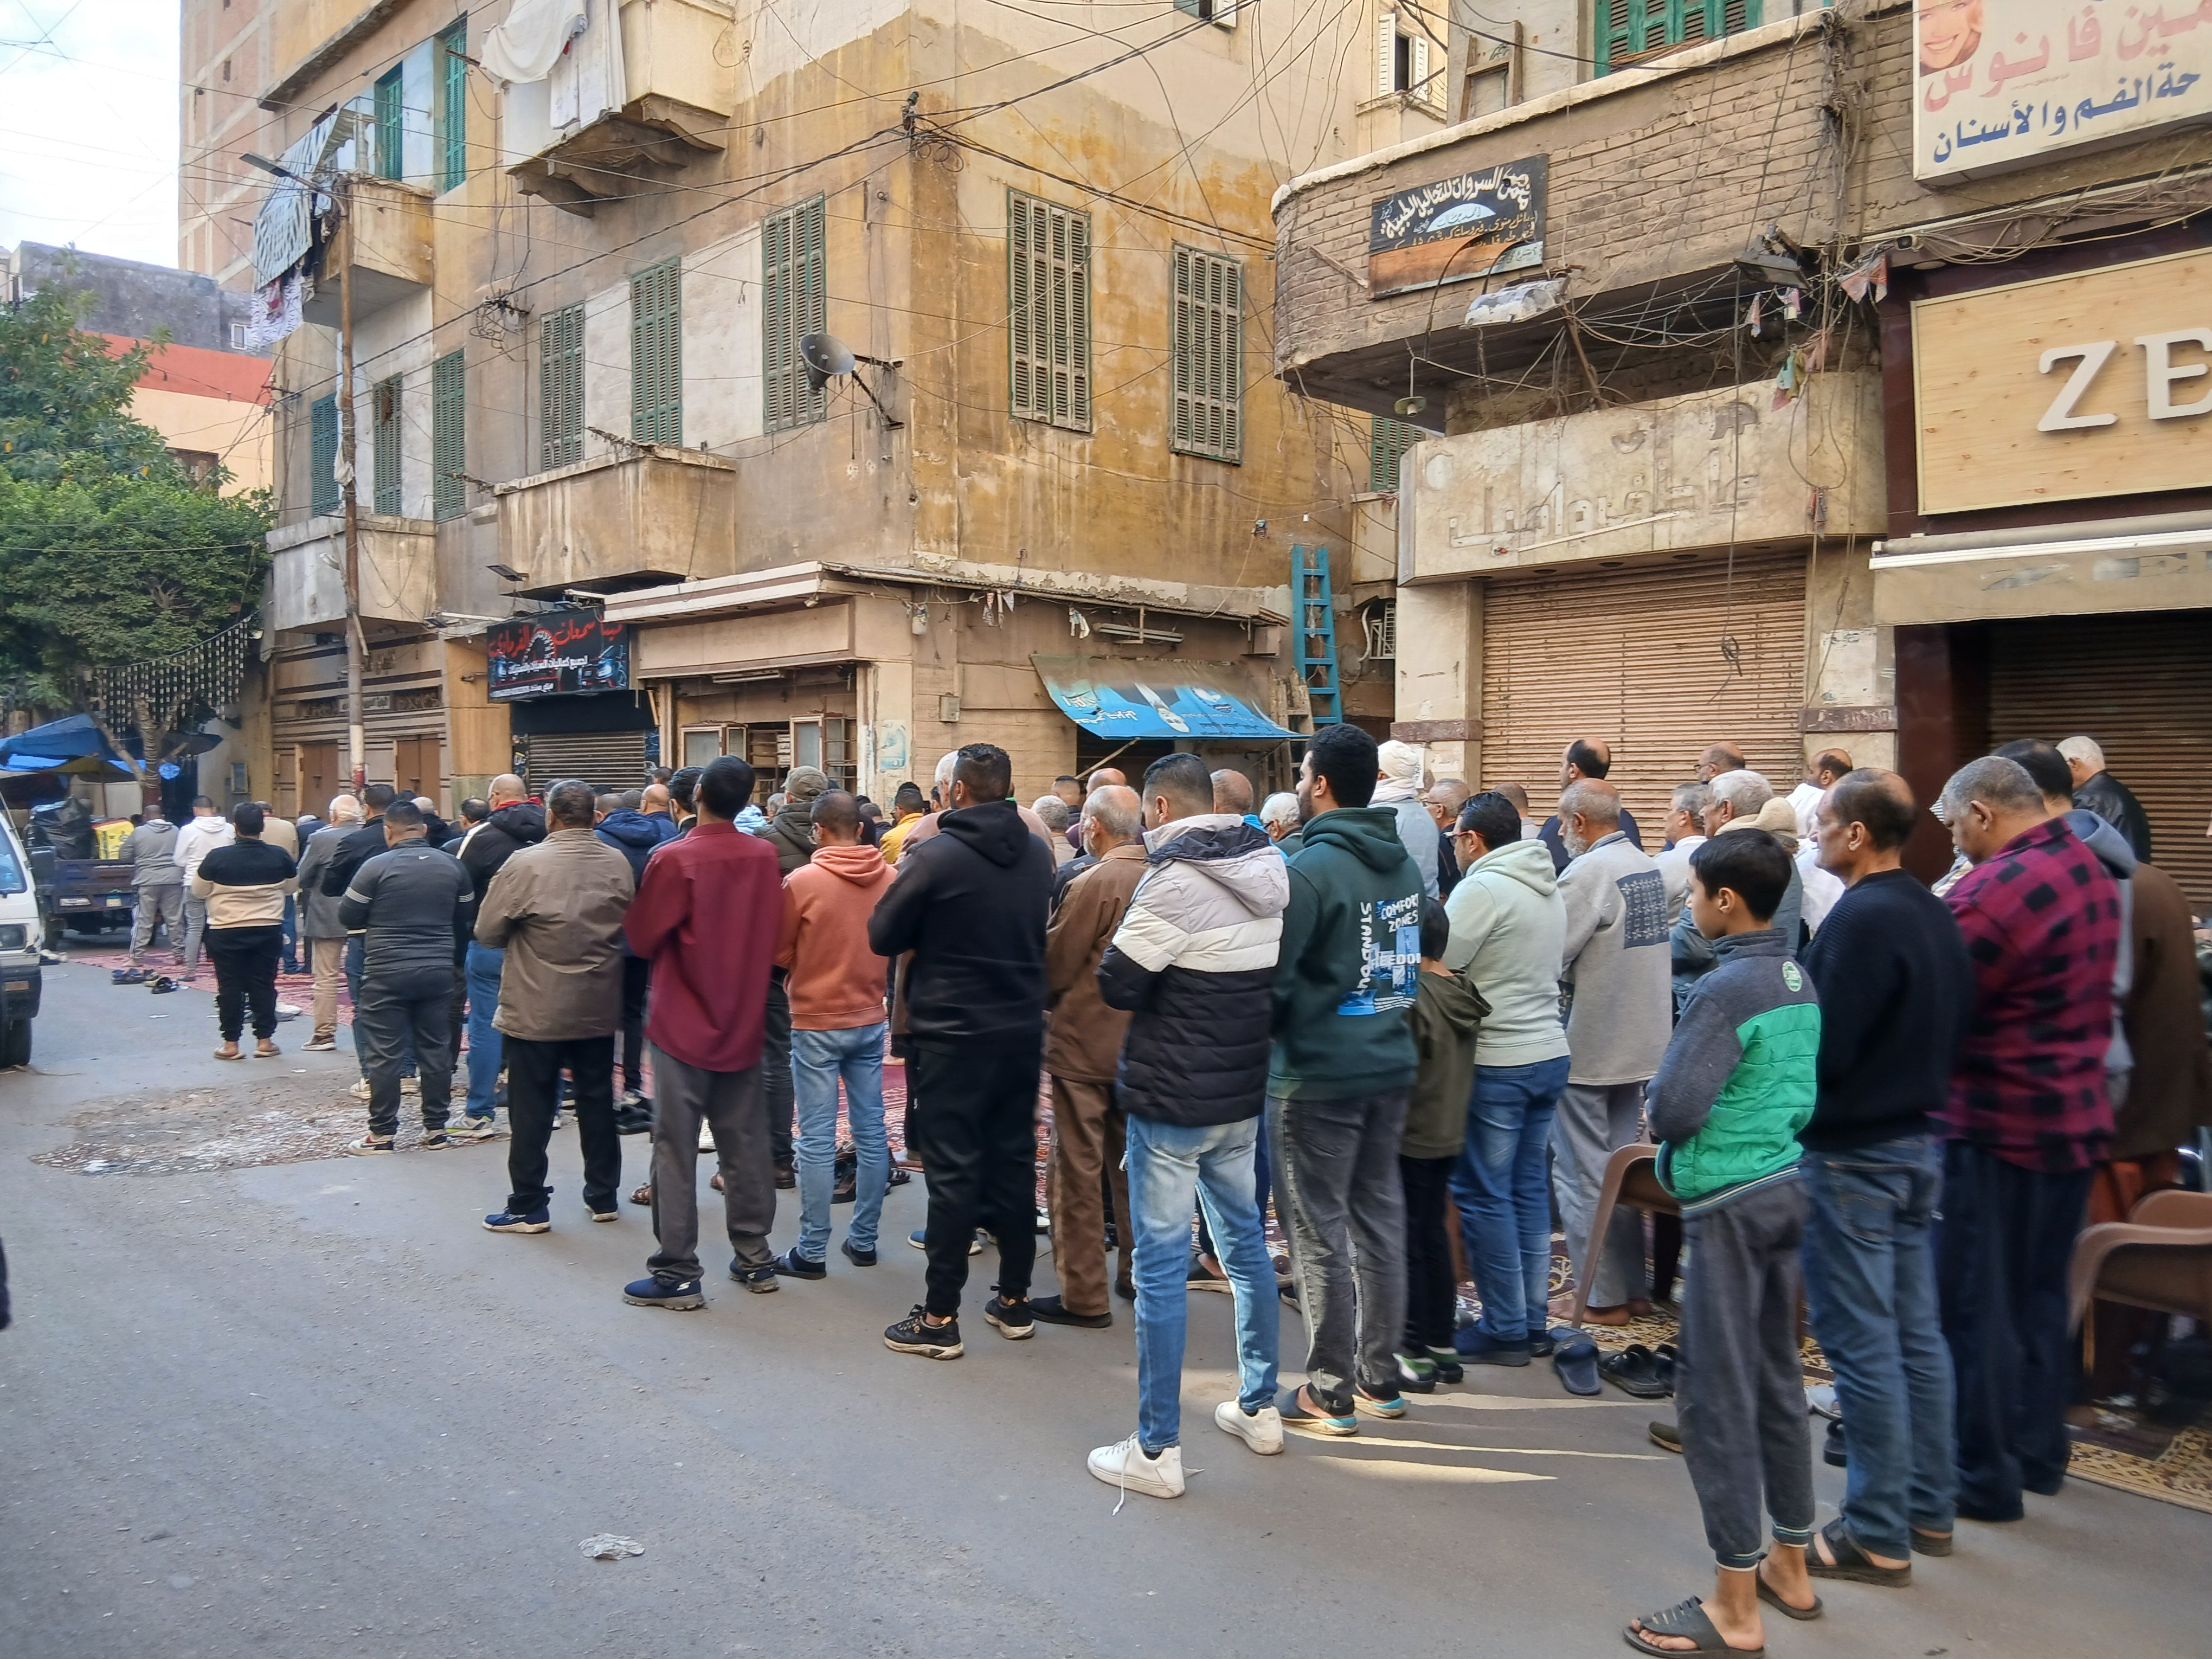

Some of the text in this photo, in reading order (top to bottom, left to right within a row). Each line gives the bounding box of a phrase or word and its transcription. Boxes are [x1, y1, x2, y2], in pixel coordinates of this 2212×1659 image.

[1924, 5, 2101, 112] فانوس
[2075, 74, 2153, 131] الفم
[1933, 100, 2066, 163] والأسنان
[1380, 194, 1418, 239] الطبية
[1416, 179, 1452, 218] للتحاليل
[2037, 327, 2212, 432] ZE
[1388, 910, 1418, 933] ZONES
